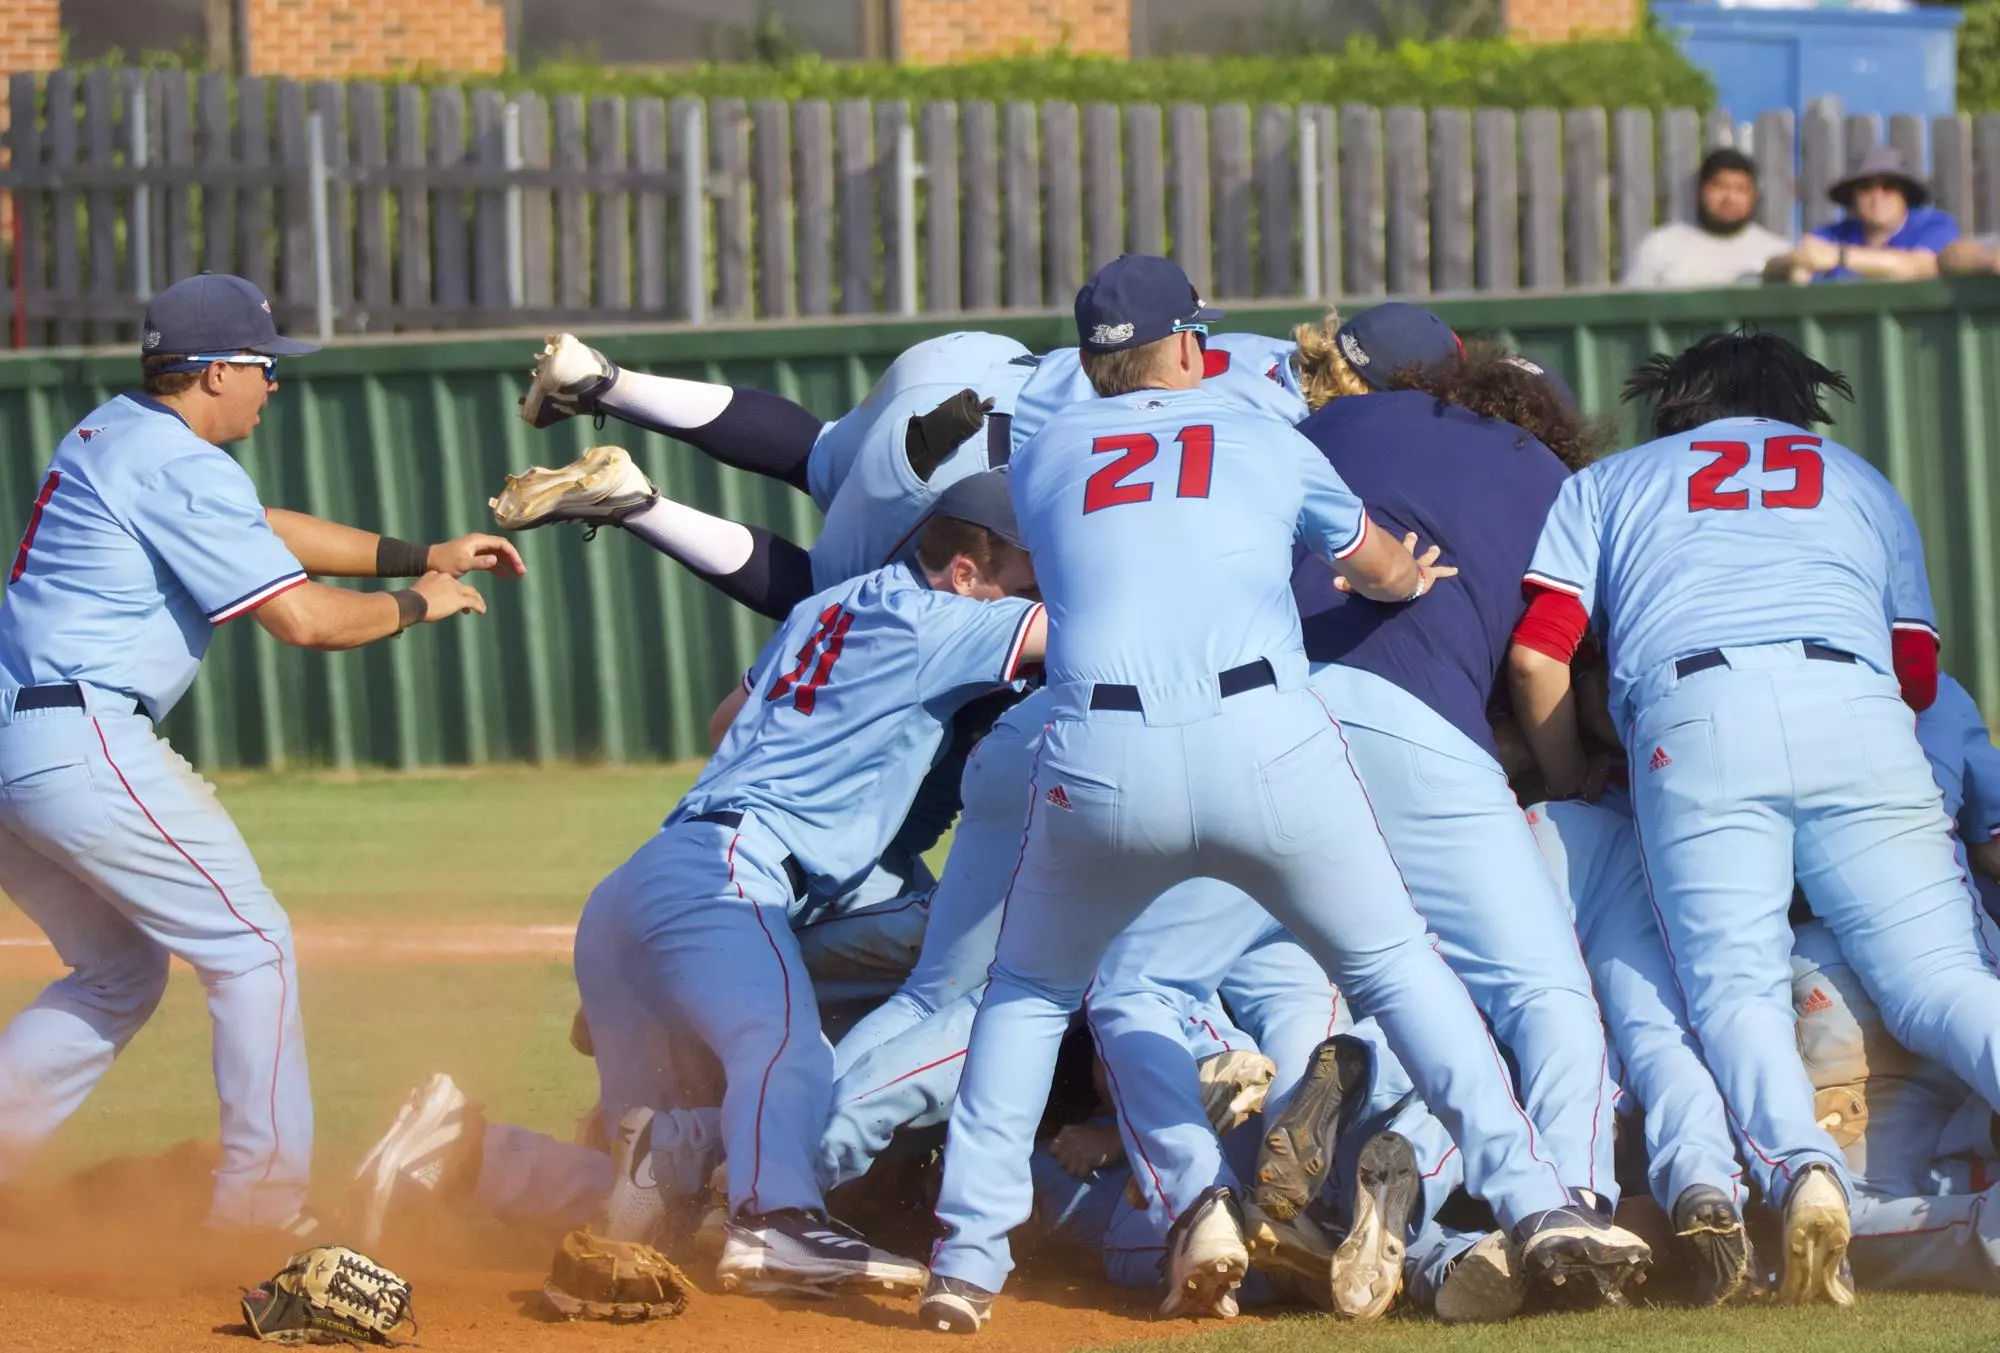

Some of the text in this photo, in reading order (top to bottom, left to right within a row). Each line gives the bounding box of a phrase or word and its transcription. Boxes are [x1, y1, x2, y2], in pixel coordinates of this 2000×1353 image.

[1083, 425, 1214, 515] 21
[1688, 435, 1824, 513] 25
[765, 602, 855, 716] 11
